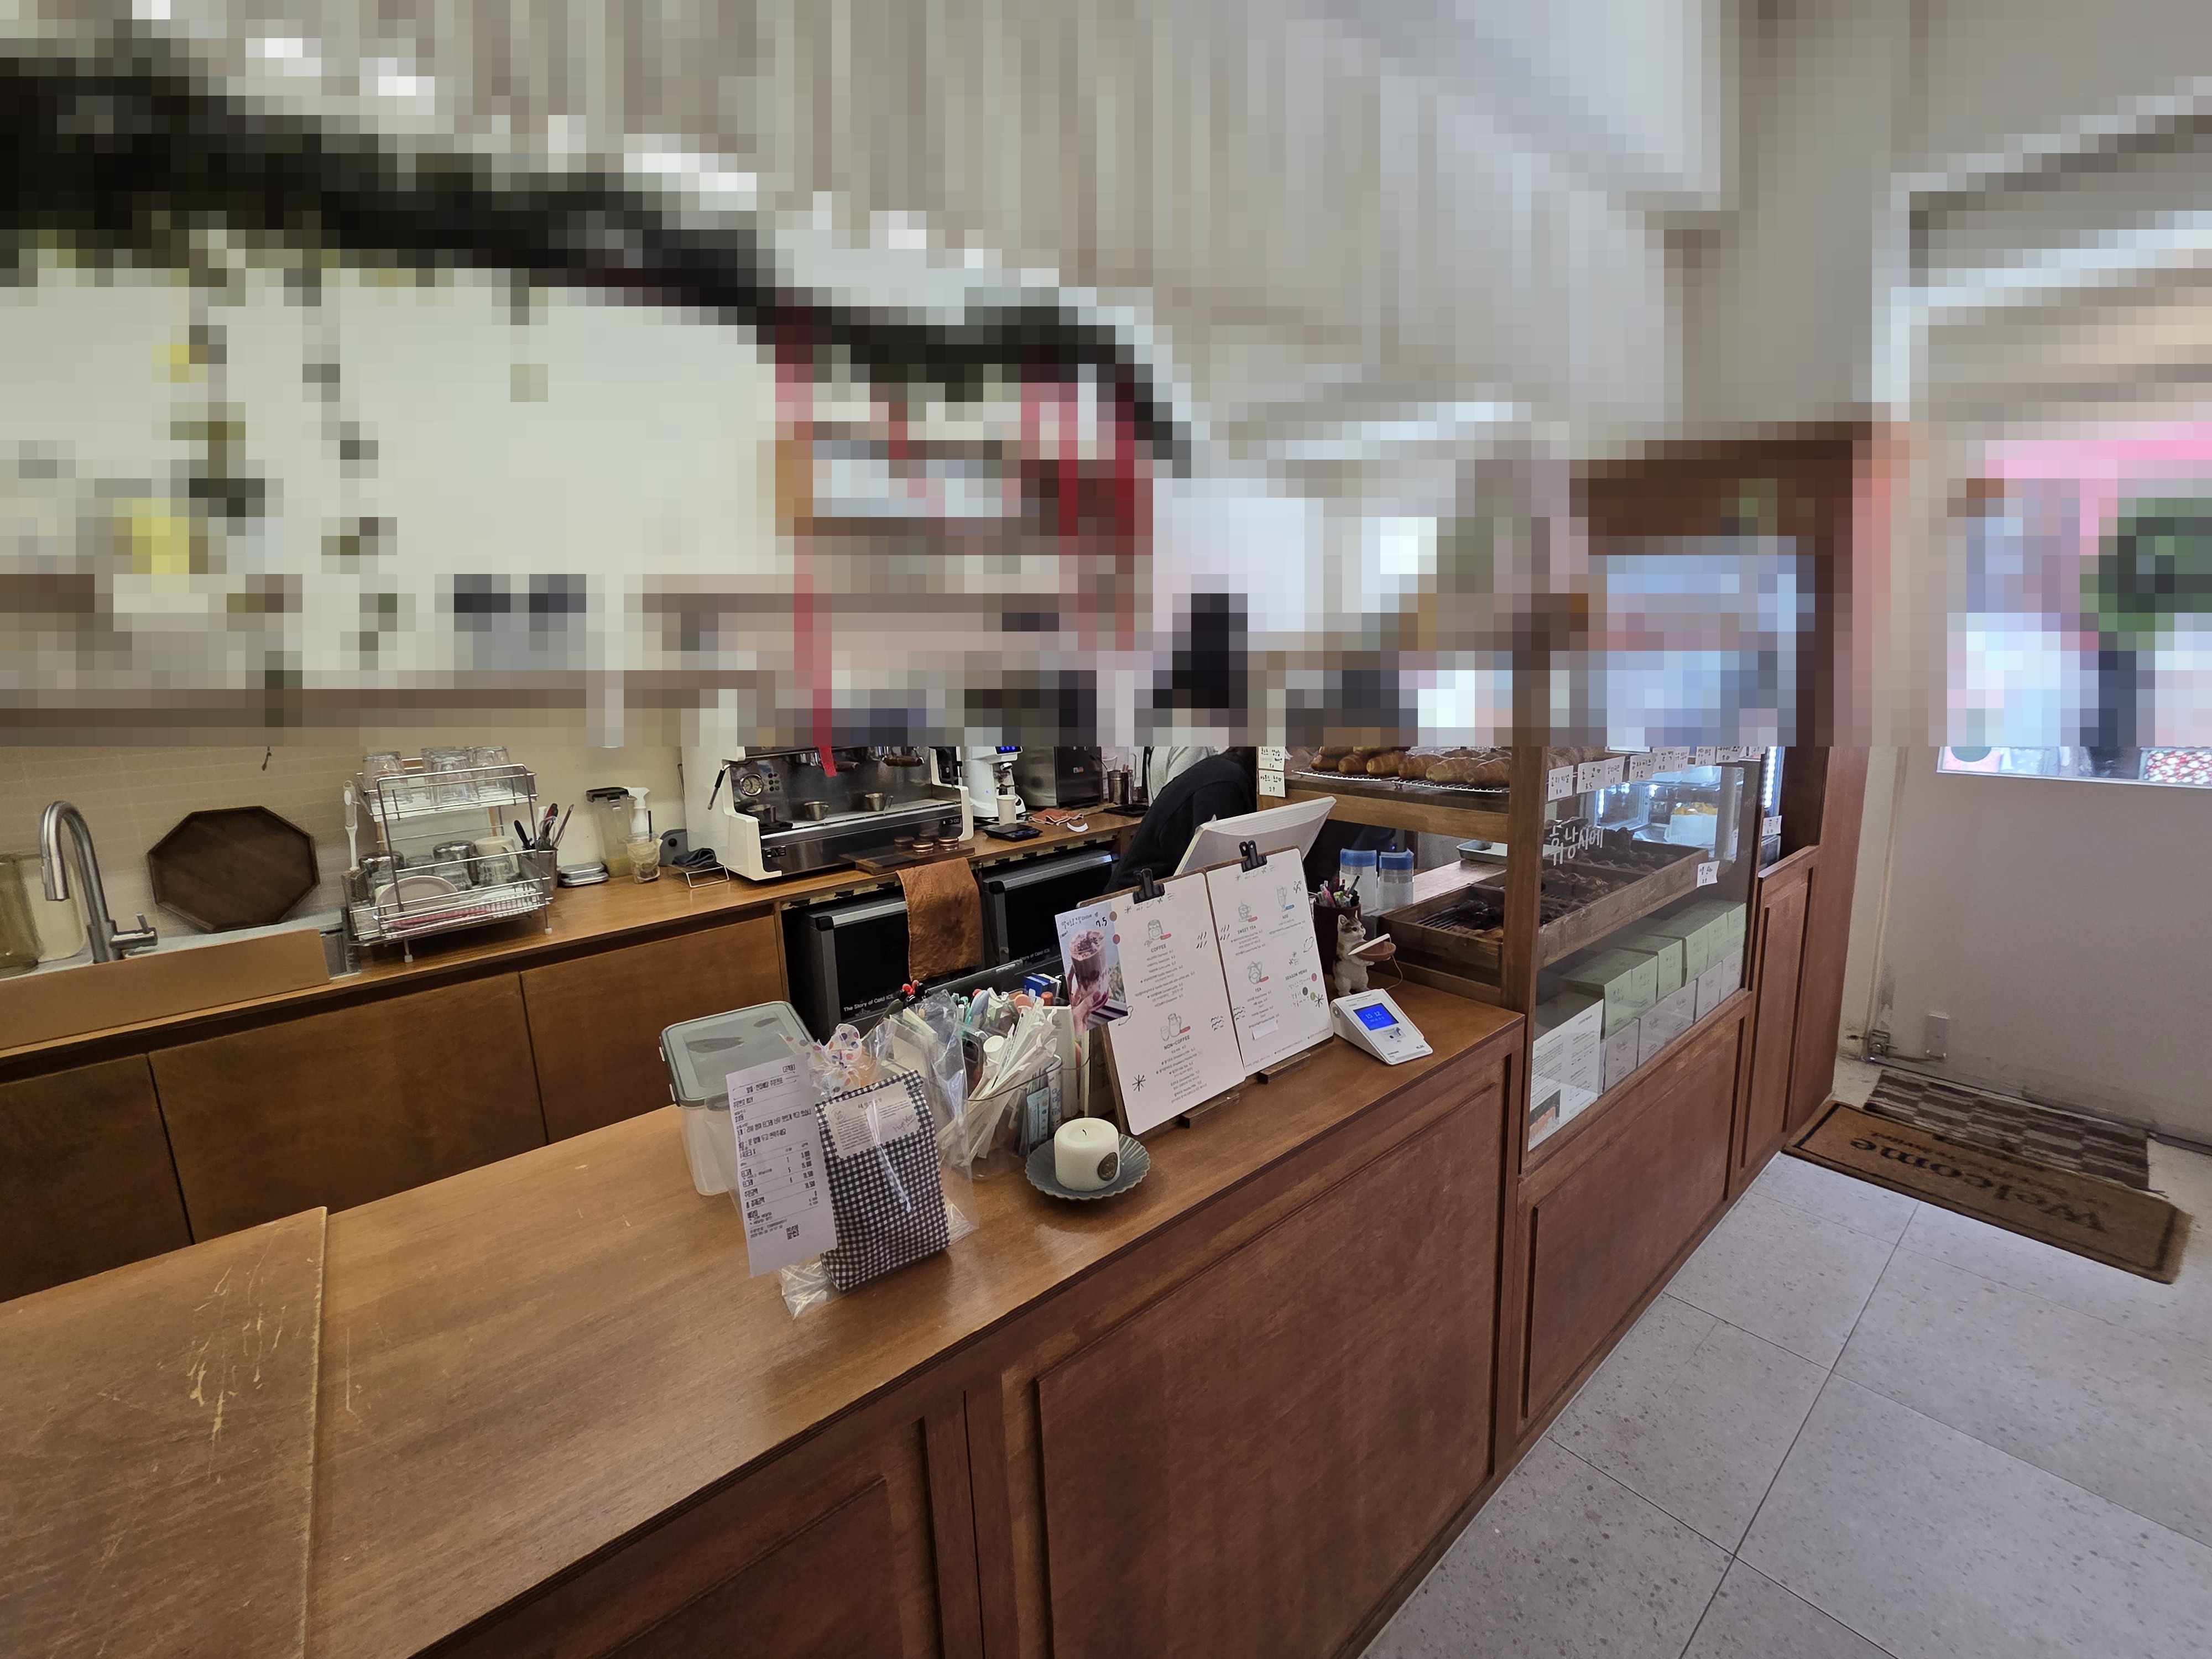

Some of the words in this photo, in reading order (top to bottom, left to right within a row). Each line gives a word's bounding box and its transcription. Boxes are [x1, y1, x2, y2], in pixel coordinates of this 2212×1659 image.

[1095, 916, 1107, 927] 7.5
[1151, 943, 1167, 953] COFFEE
[1164, 1035, 1190, 1050] NON-COFFEE
[1850, 1137, 2108, 1234] Welcome
